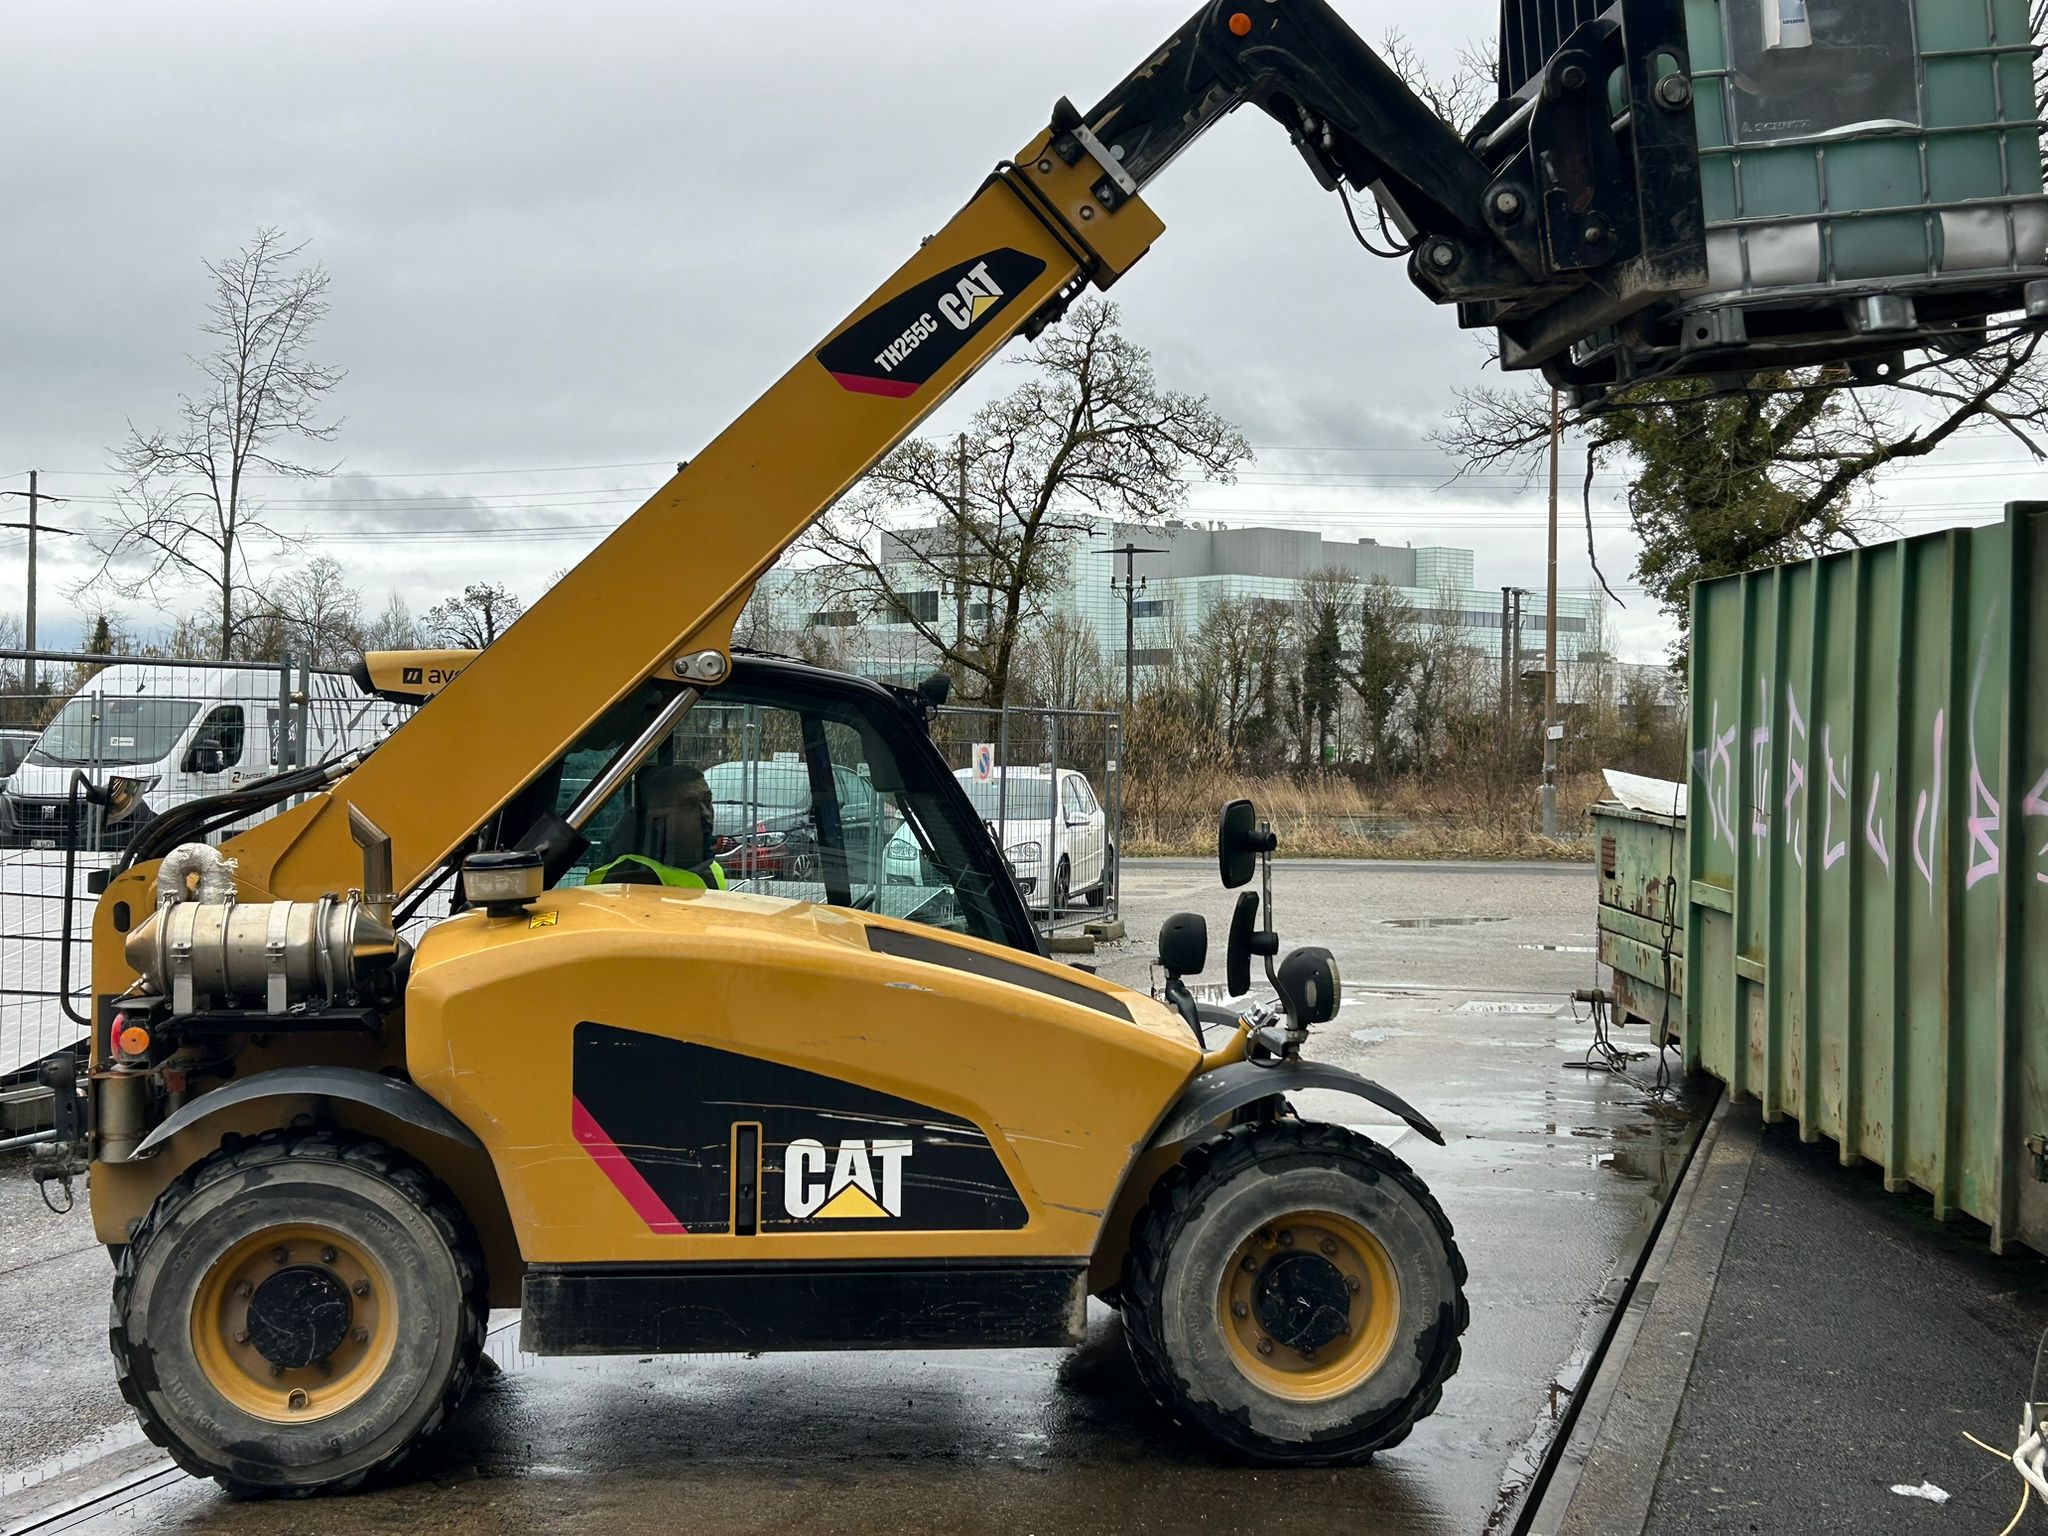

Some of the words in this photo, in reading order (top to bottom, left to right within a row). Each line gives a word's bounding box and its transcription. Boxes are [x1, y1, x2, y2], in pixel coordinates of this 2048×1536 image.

[938, 261, 1004, 331] CAT
[874, 312, 938, 373] TH255C
[784, 1138, 913, 1219] CAT
